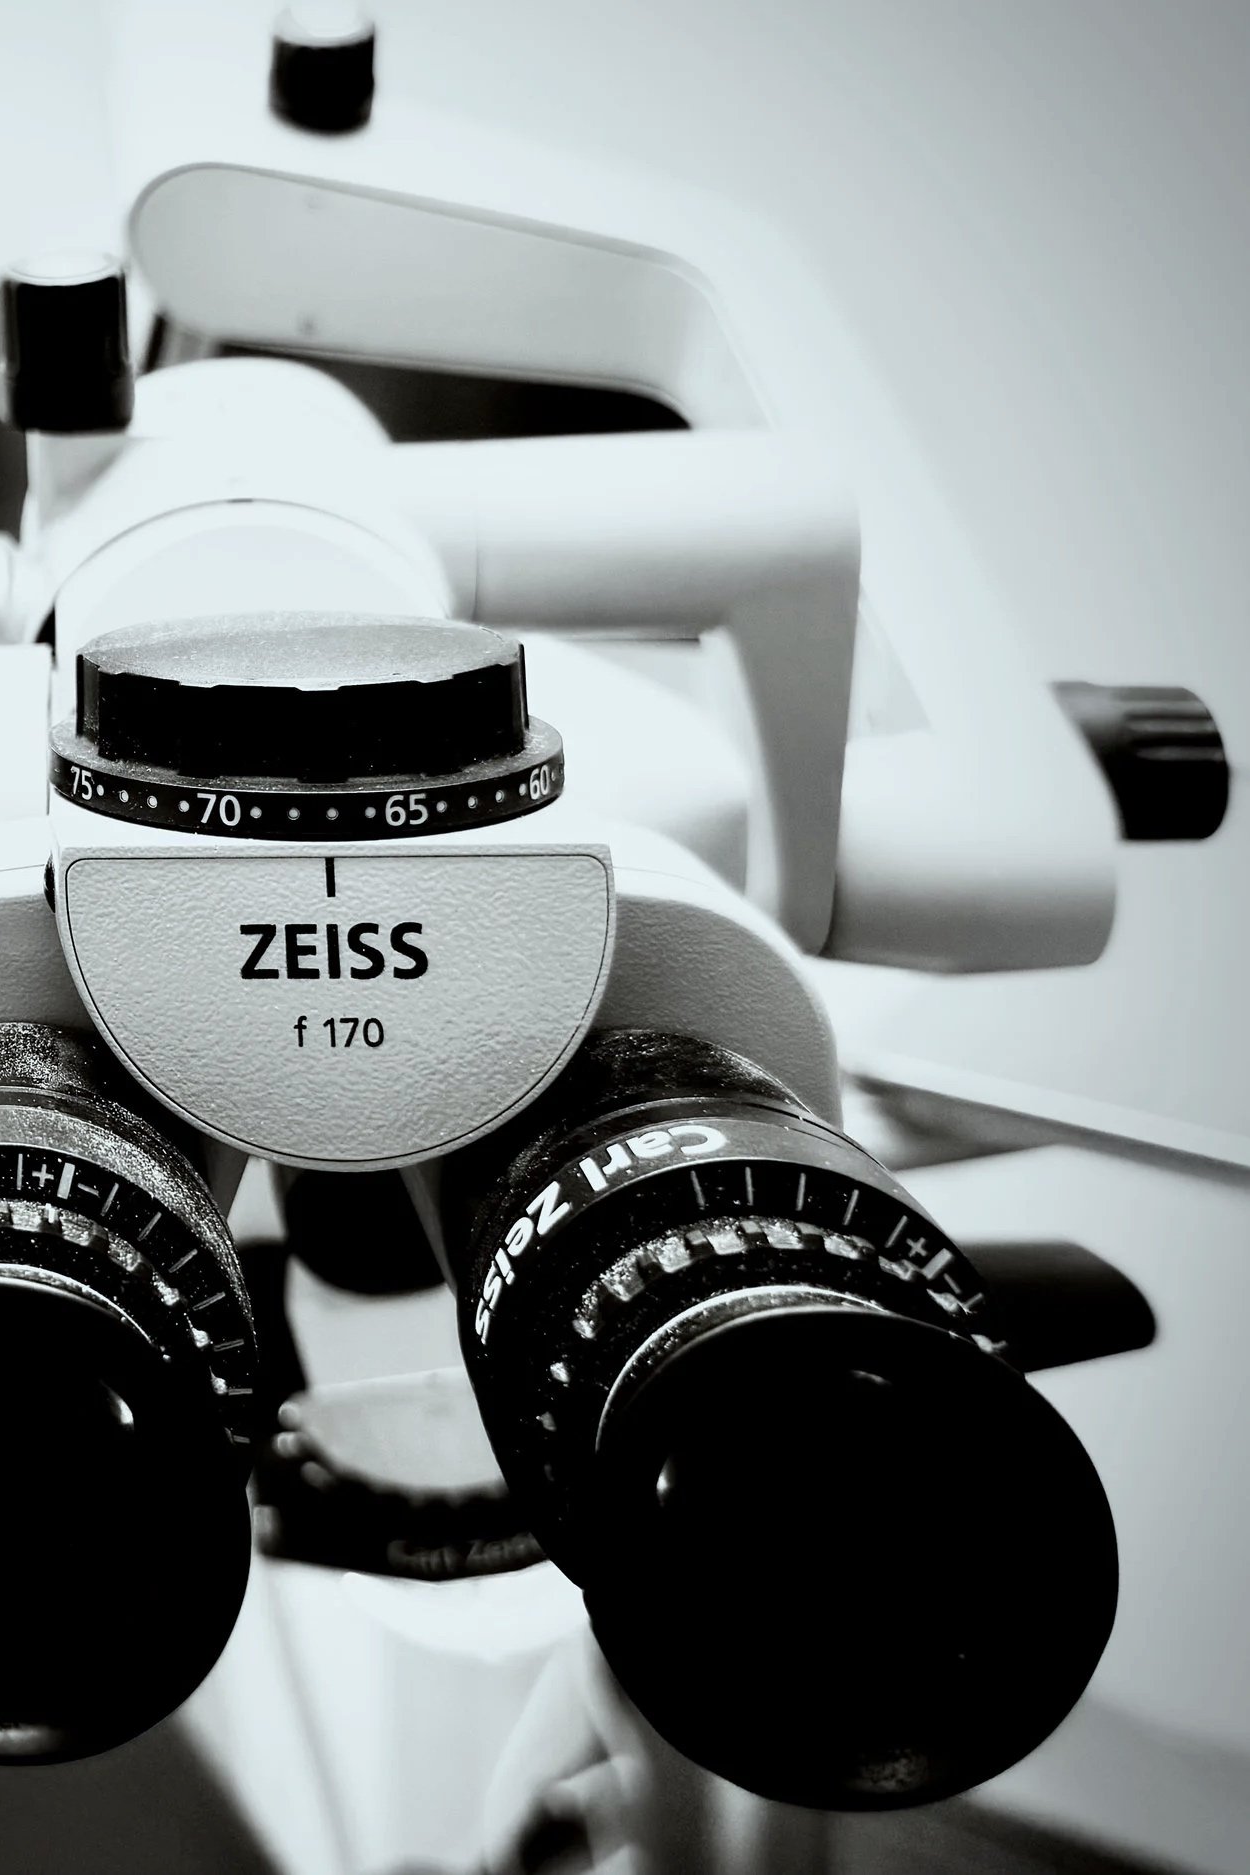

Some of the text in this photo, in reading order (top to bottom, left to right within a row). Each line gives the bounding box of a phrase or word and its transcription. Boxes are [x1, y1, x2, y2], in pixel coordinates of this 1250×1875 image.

[70, 764, 550, 827] 75 70 65 60
[239, 921, 430, 981] ZEISS
[293, 1015, 385, 1048] f 170
[475, 1124, 729, 1345] Carl Zeiss
